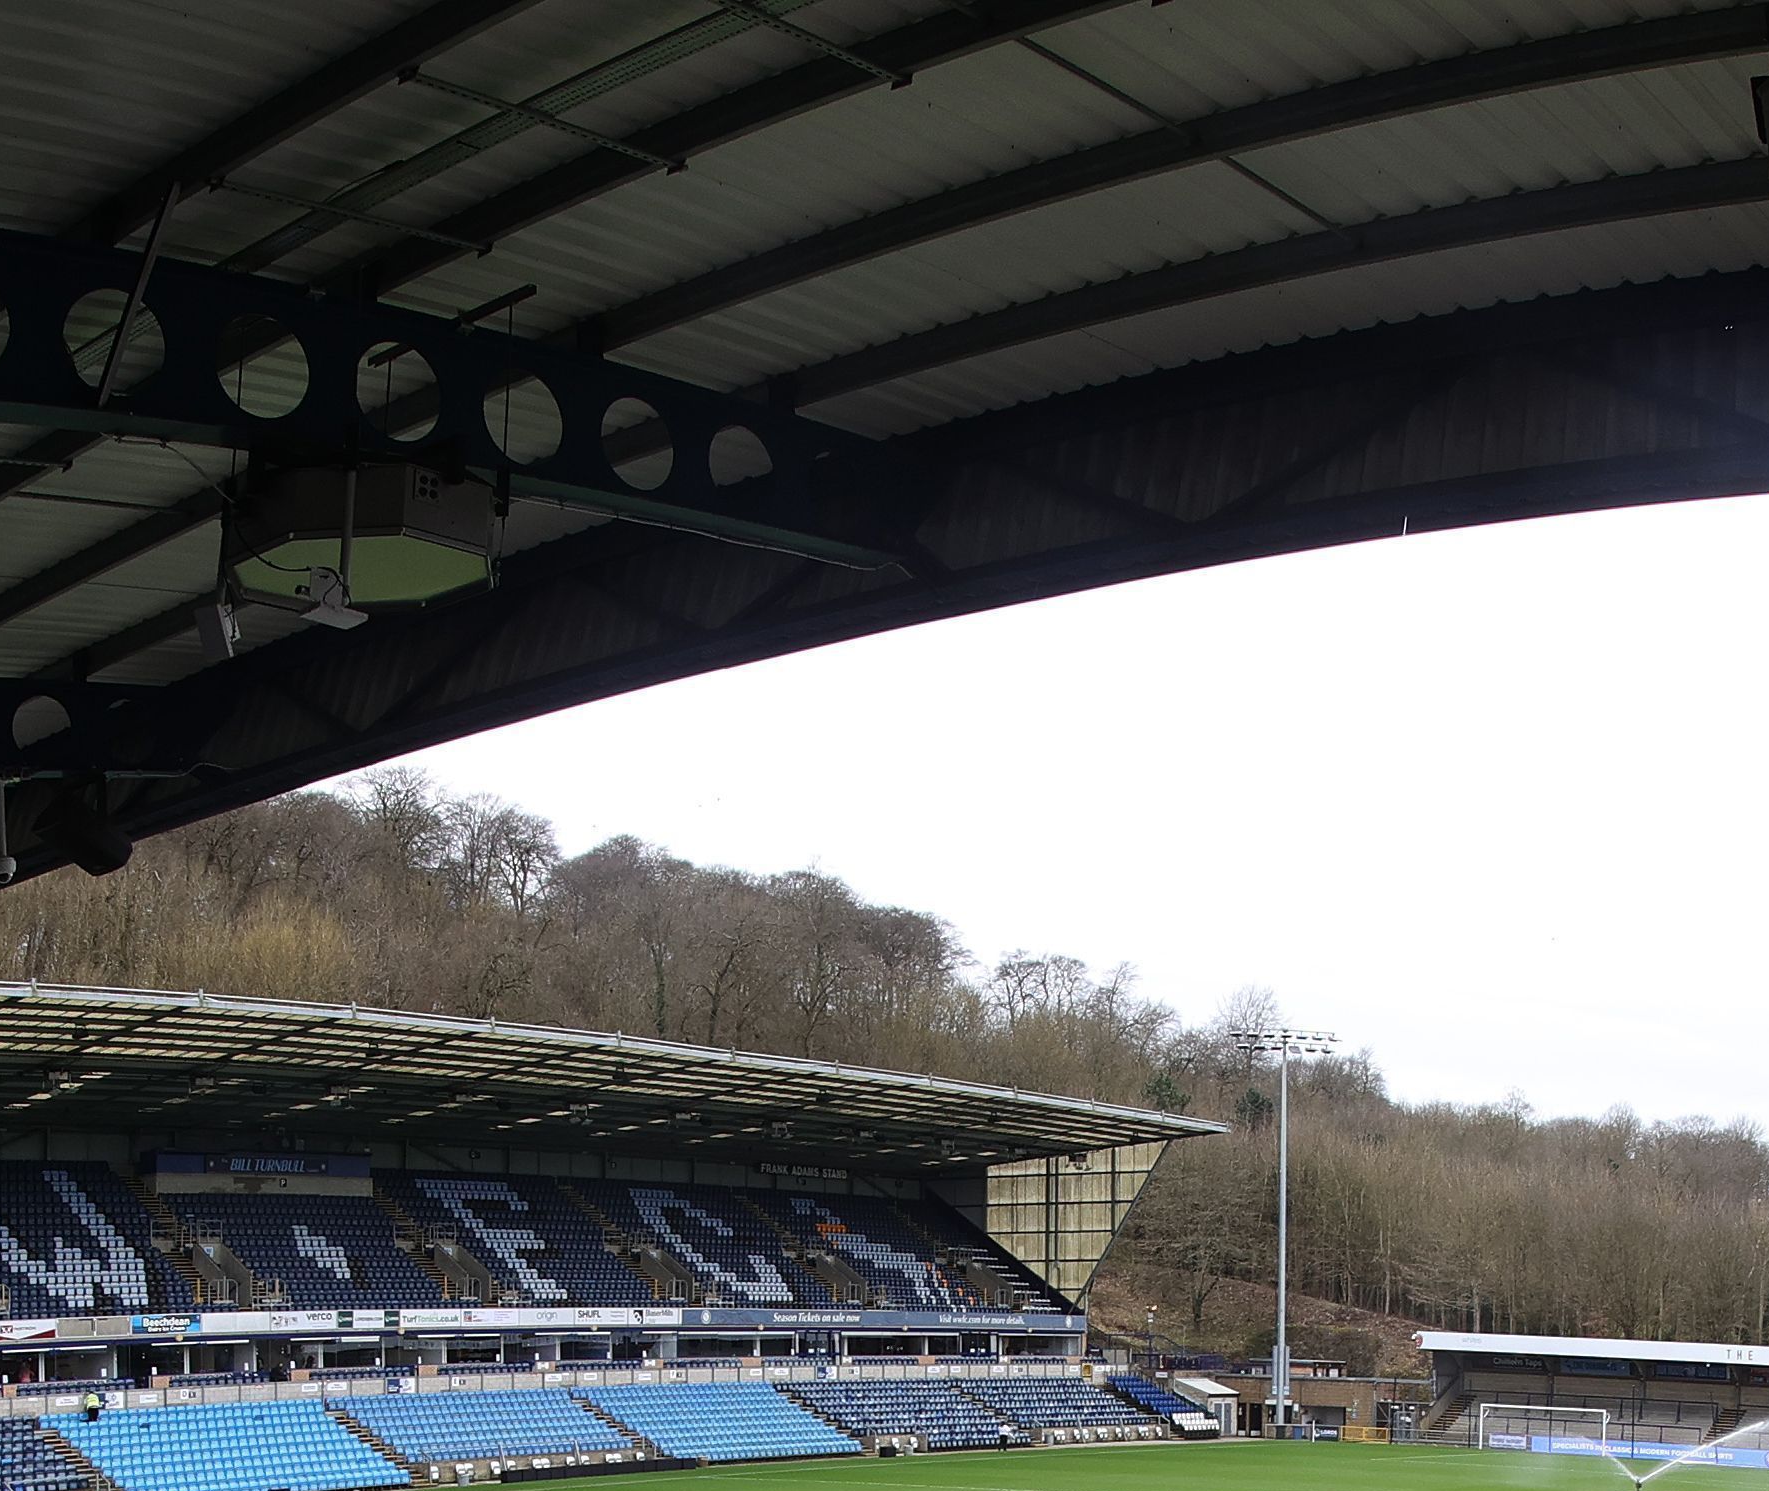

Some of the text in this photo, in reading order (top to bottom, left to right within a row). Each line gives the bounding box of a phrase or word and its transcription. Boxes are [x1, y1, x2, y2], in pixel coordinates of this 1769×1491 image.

[231, 1158, 252, 1171] BILL
[254, 1158, 305, 1173] TURNBULL
[761, 1163, 848, 1180] FRANK ADAMS STAND
[142, 1317, 190, 1328] Beechdean
[306, 1313, 332, 1321] verco
[773, 1312, 797, 1322] Season
[798, 1312, 820, 1322] Tickets
[832, 1312, 845, 1322] sale
[939, 1315, 951, 1323] Visit
[982, 1315, 990, 1324] for
[1726, 1349, 1753, 1361] THE
[1552, 1442, 1594, 1451] SPECIALISTS
[1639, 1448, 1669, 1456] MODERN
